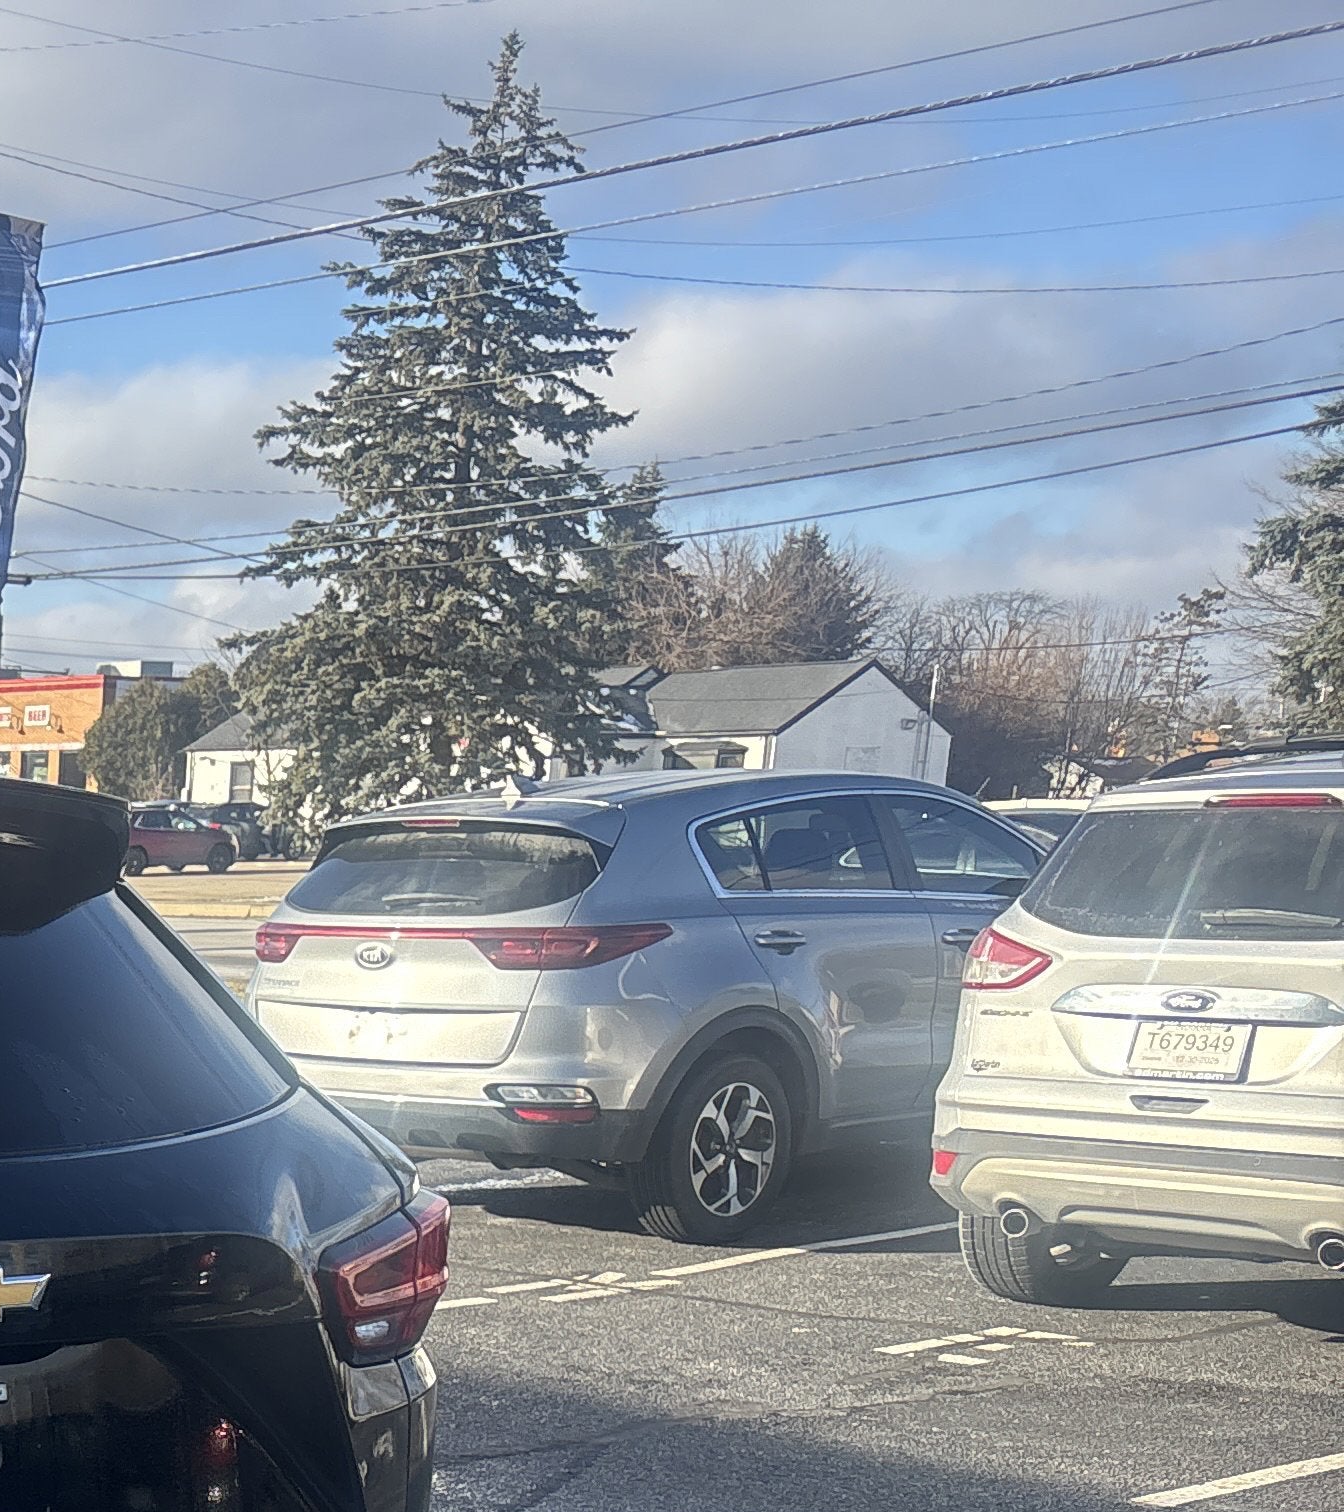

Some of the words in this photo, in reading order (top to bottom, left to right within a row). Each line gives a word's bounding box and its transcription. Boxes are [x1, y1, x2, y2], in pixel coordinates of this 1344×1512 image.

[27, 709, 48, 723] BEER
[1168, 994, 1203, 1009] Ford
[1147, 1031, 1235, 1053] T679349
